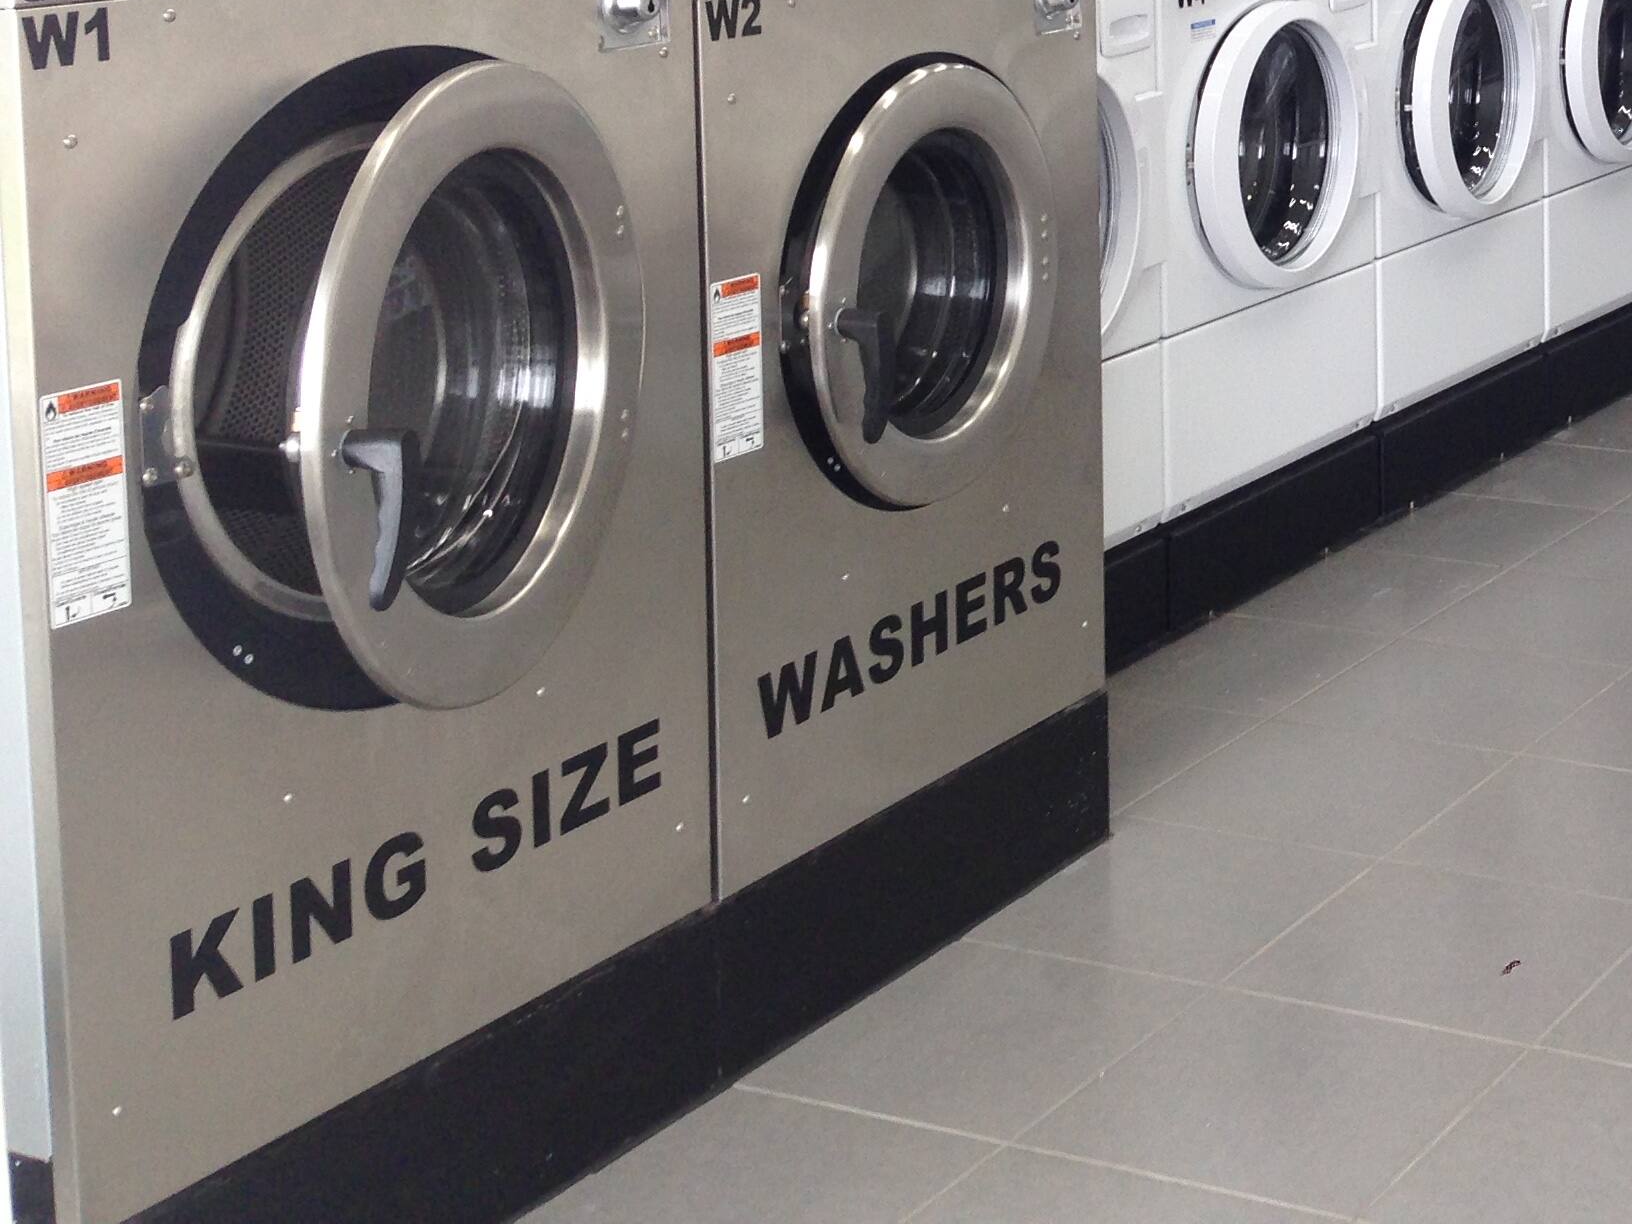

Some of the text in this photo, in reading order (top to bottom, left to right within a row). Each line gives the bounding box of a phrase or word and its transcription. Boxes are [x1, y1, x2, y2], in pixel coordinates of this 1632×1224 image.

[22, 7, 110, 71] W1
[757, 540, 1063, 740] WASHERS
[170, 719, 662, 1021] KING SIZE
